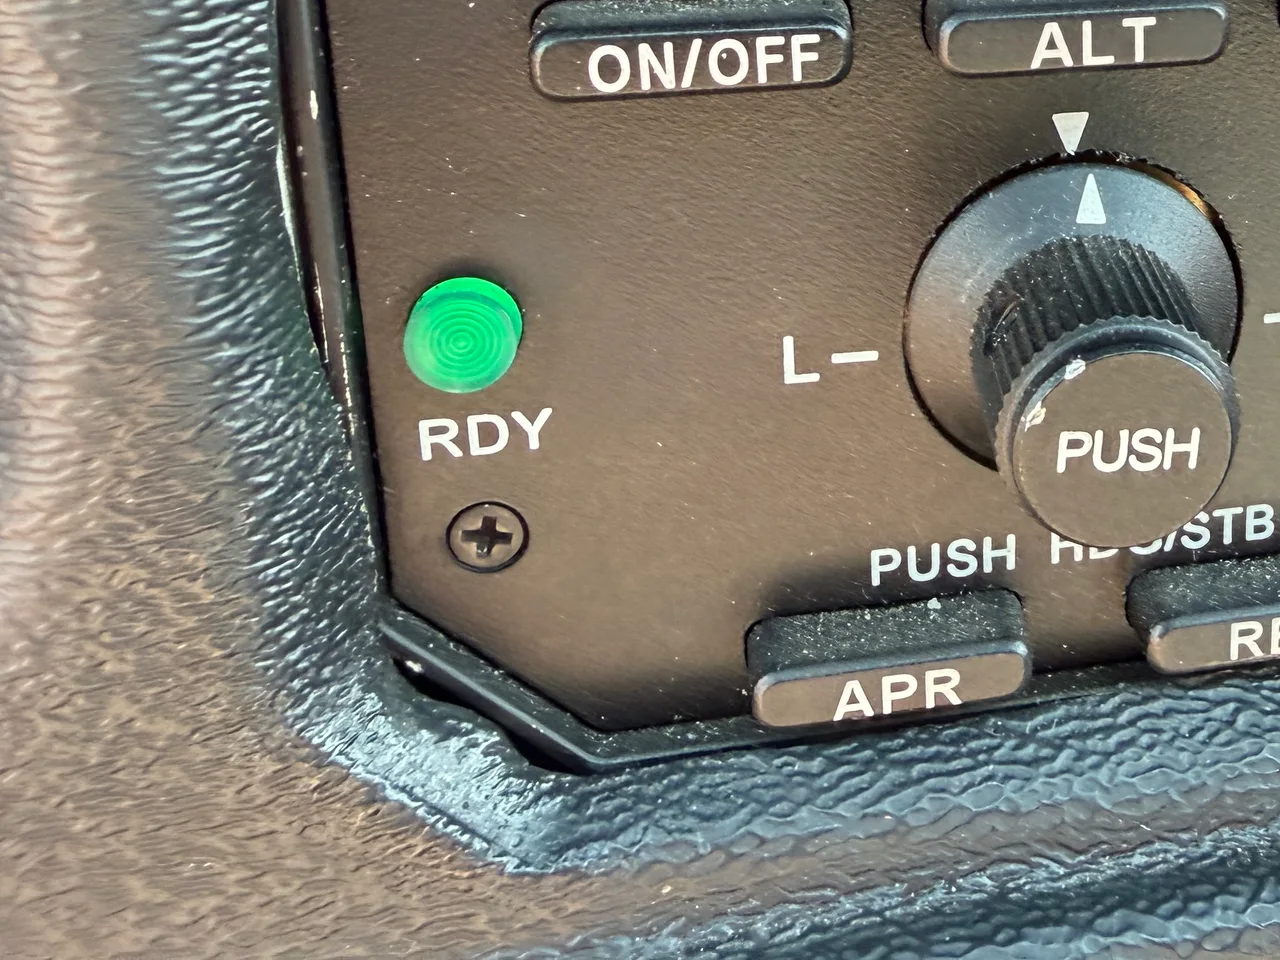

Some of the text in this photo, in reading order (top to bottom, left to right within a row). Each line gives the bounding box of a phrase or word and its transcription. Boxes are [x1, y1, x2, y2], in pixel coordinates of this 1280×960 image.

[588, 33, 821, 93] ON/OFF
[1030, 16, 1157, 69] ALT
[782, 335, 821, 384] L
[417, 407, 553, 461] RDY
[1056, 427, 1201, 474] PUSH
[869, 534, 1017, 587] PUSH
[832, 668, 963, 722] APR
